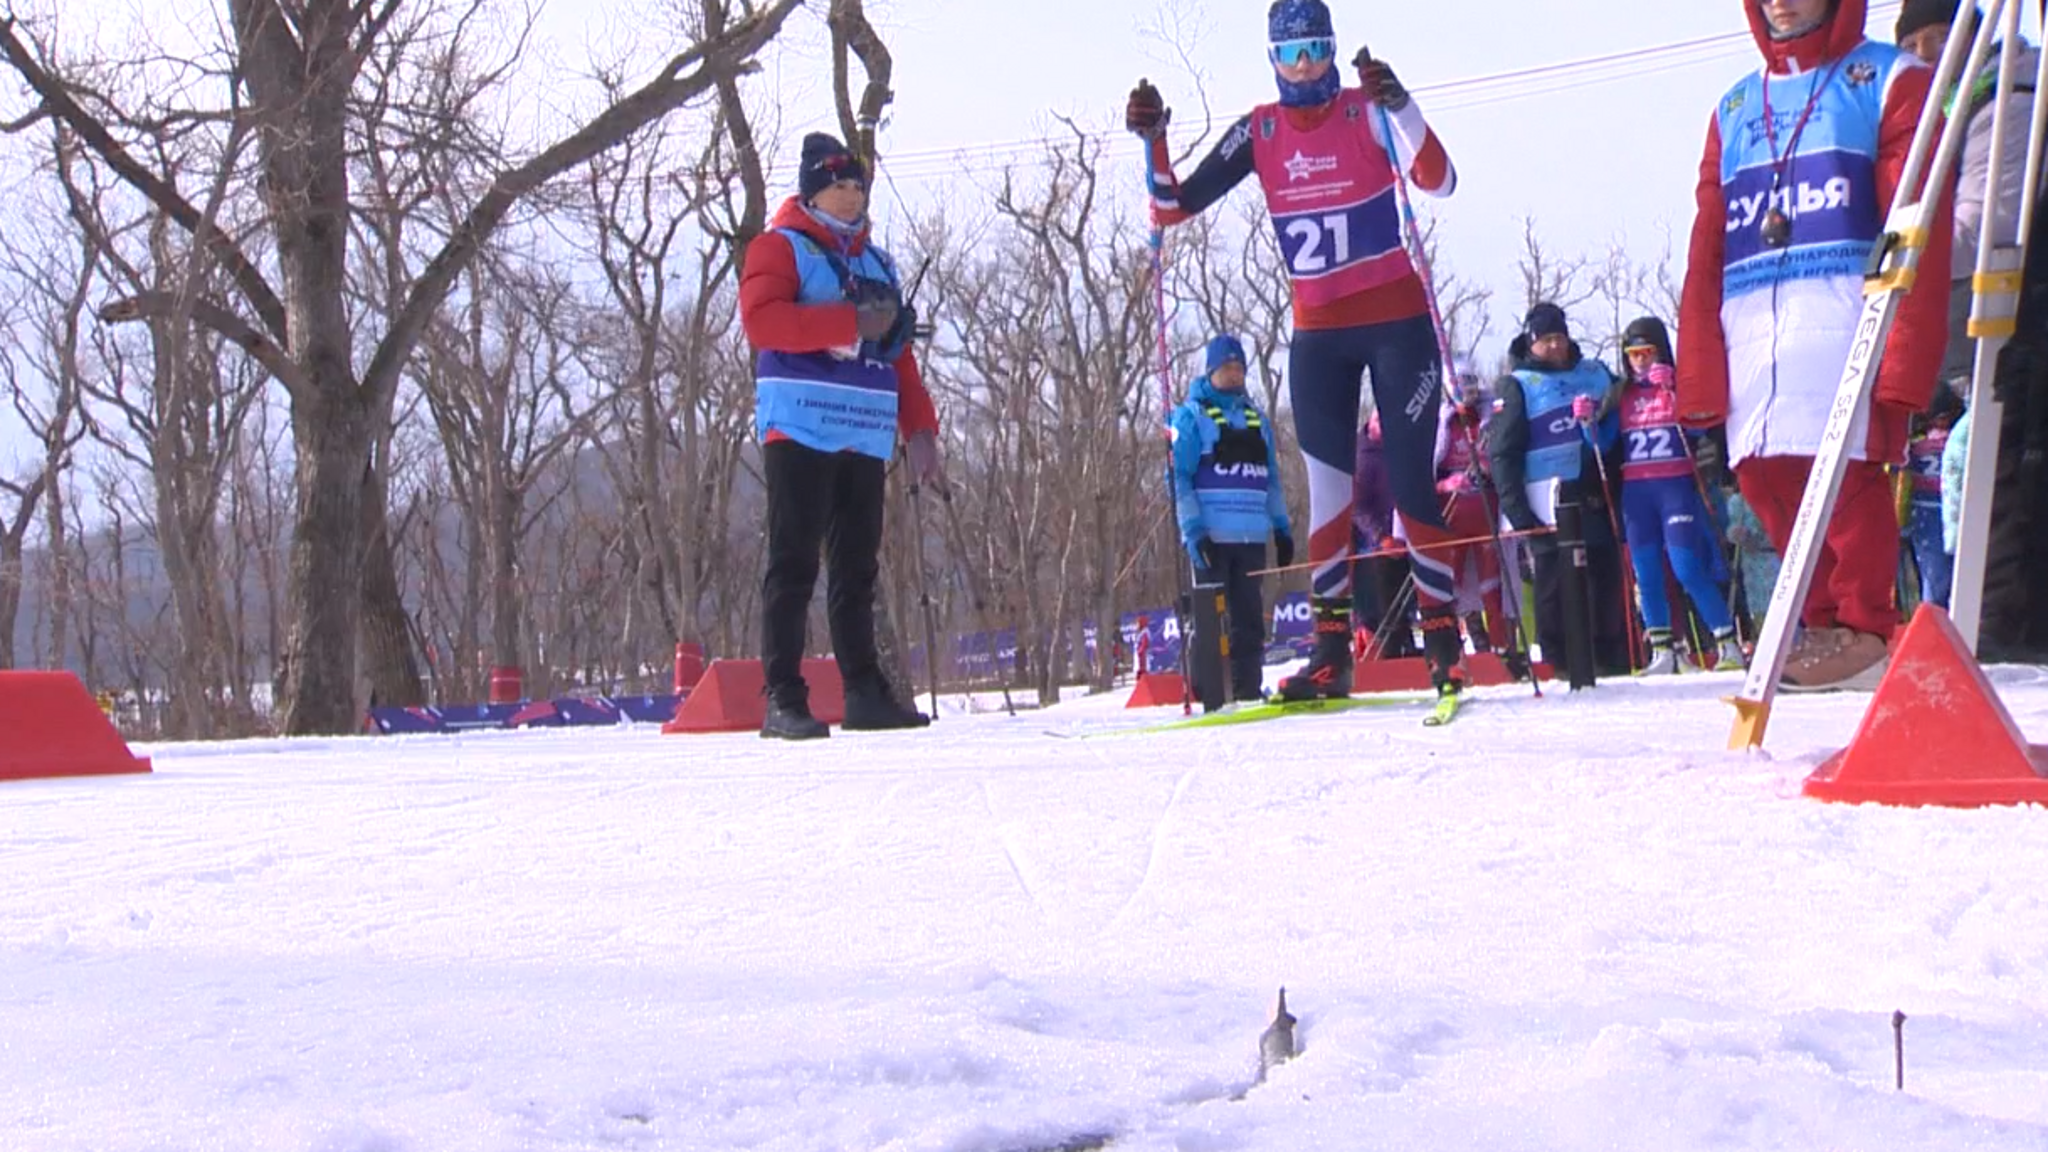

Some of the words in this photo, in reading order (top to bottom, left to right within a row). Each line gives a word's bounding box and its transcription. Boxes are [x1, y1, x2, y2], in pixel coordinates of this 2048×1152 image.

[1285, 213, 1349, 271] 21
[1844, 294, 1886, 384] VEGA
[1628, 428, 1673, 460] 22
